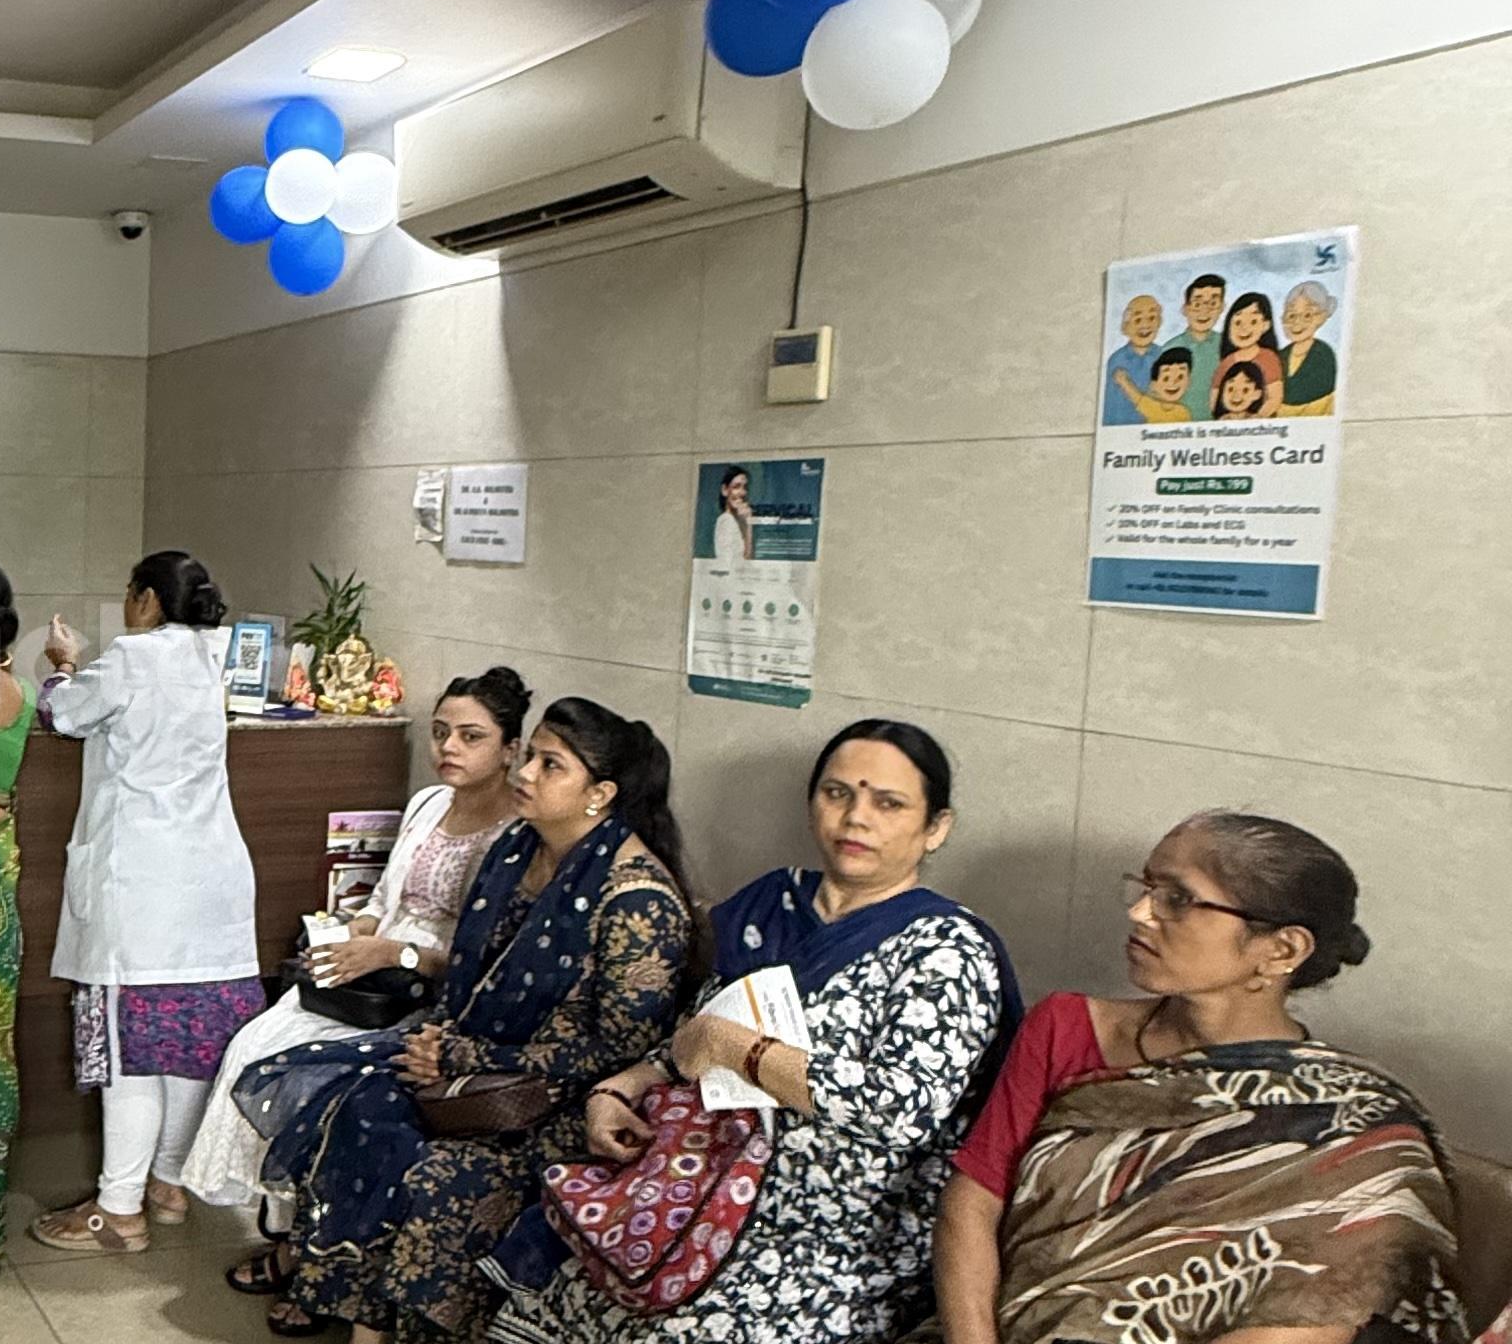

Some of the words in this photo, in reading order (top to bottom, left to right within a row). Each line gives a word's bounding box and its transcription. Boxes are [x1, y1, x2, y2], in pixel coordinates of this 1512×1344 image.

[1197, 426, 1206, 438] is
[1209, 423, 1289, 439] relaunching
[1103, 450, 1166, 473] Family
[1170, 446, 1264, 468] Wellness
[1270, 444, 1326, 465] Card
[1160, 480, 1181, 492] Pay
[1182, 479, 1205, 492] just
[1142, 504, 1161, 514] OFF
[1163, 506, 1176, 514] on
[1177, 504, 1212, 517] Family
[1213, 504, 1243, 514] Clinic
[1245, 505, 1321, 515] consultations
[1140, 519, 1160, 529] OFF
[1161, 521, 1174, 529] on
[1202, 520, 1221, 530] and
[1118, 534, 1141, 543] Valid
[1142, 534, 1156, 543] for
[1160, 535, 1174, 543] the
[1177, 535, 1208, 544] whole
[1209, 535, 1242, 548] family
[1245, 536, 1260, 546] for
[1262, 538, 1270, 546] a
[1271, 538, 1297, 549] year
